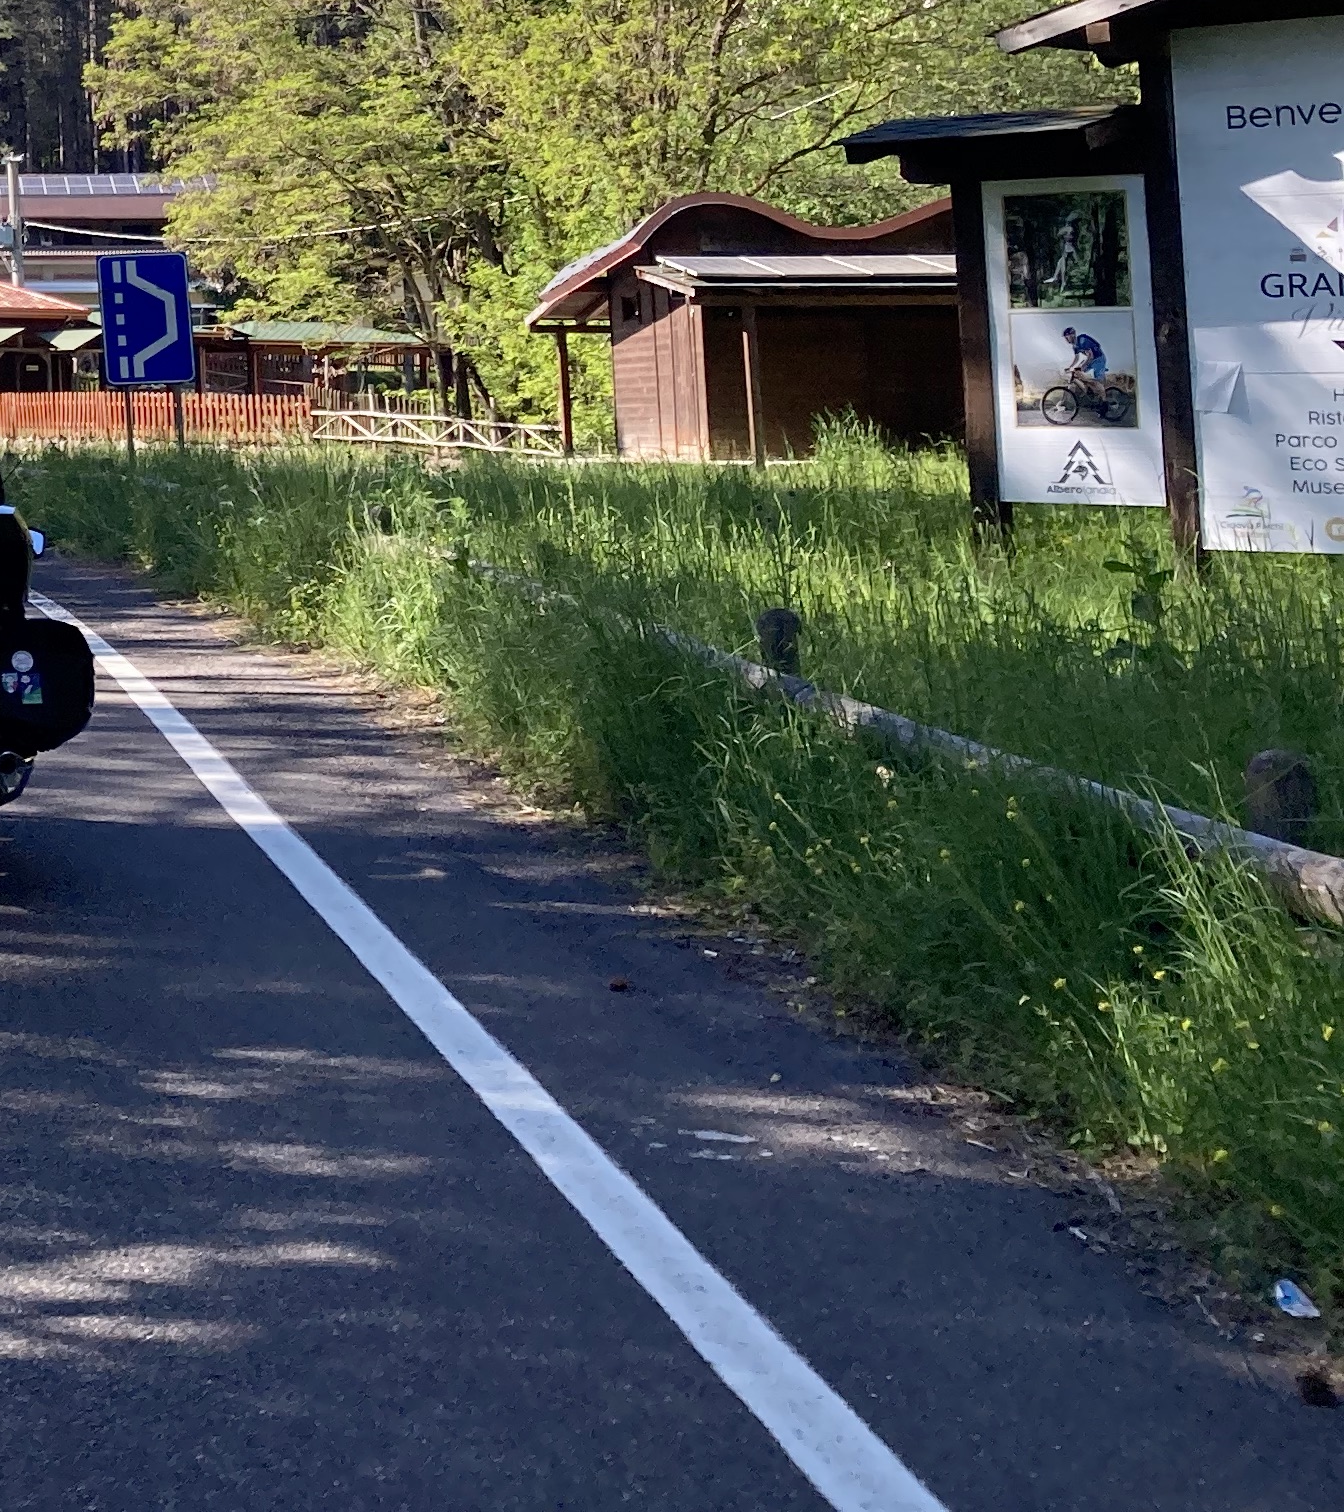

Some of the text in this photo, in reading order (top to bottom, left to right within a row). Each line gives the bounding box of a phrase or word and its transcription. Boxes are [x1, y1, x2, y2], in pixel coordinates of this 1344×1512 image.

[1226, 102, 1342, 129] Benve
[1260, 272, 1344, 298] GRA
[1308, 410, 1344, 426] Rist
[1275, 434, 1338, 449] Parco
[1290, 456, 1328, 472] Eco
[1292, 479, 1344, 495] Muse
